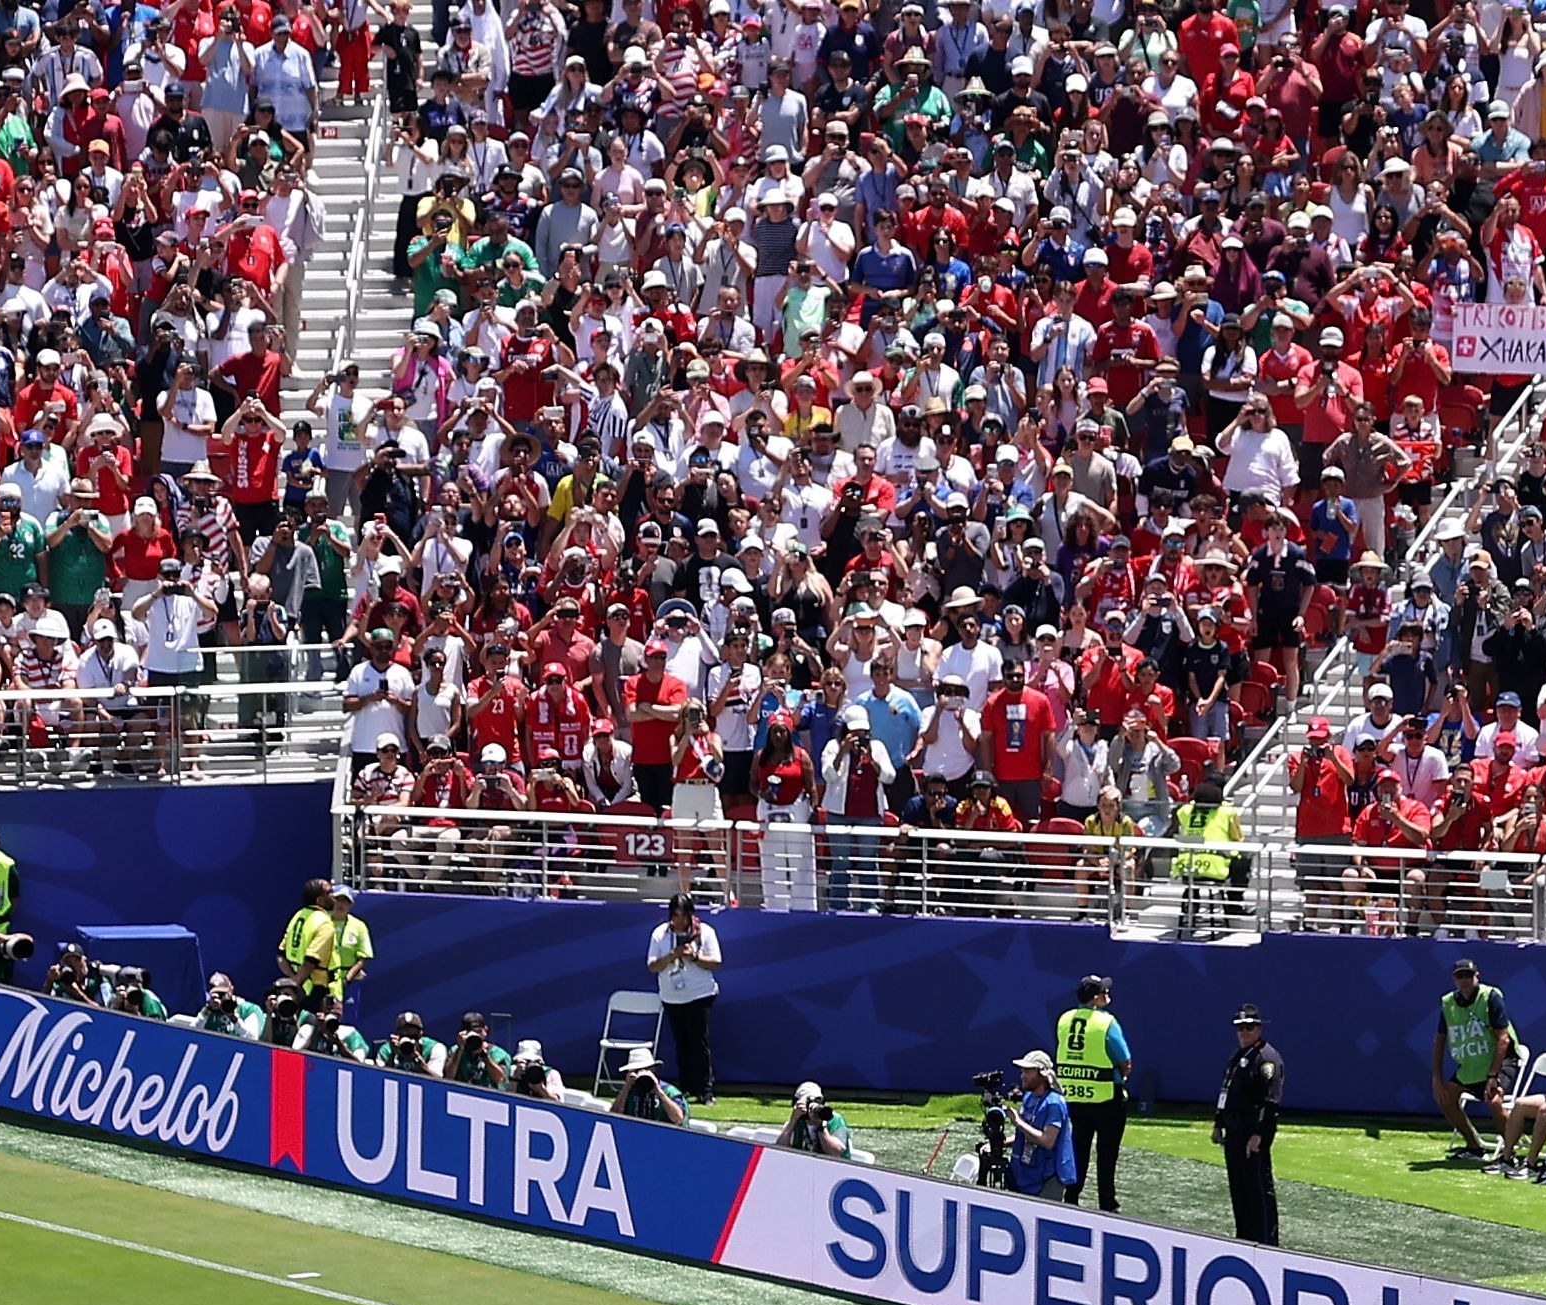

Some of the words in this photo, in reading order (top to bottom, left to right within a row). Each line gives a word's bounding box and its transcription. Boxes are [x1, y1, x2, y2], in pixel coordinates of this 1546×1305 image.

[1461, 304, 1530, 328] TRICOT
[1480, 335, 1546, 363] XHAKA
[238, 441, 250, 489] SUISSE
[492, 698, 505, 714] 23
[624, 832, 666, 856] 123
[1057, 1066, 1100, 1079] ECURITY
[336, 1069, 636, 1238] ULTRA
